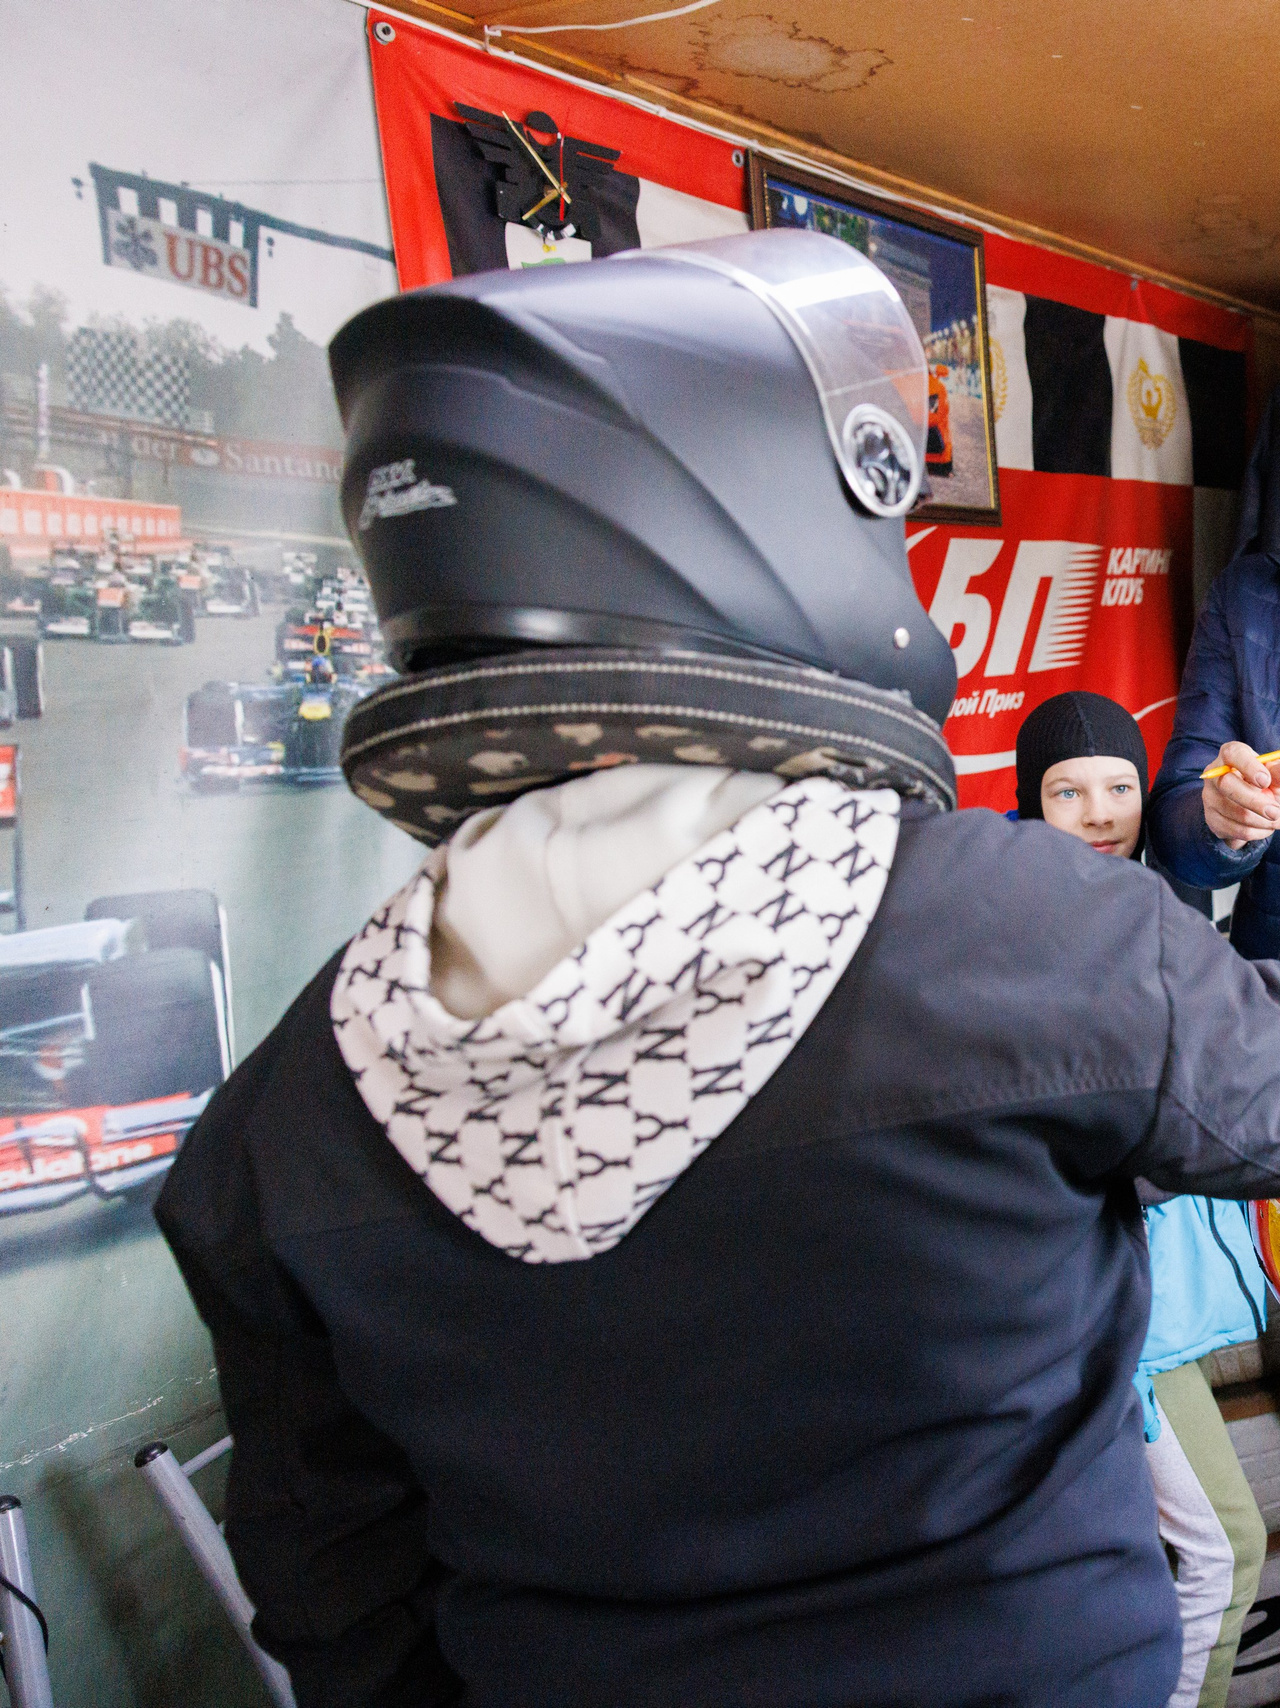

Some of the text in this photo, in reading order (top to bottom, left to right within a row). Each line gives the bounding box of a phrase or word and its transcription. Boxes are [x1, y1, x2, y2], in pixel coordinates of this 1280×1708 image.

[163, 229, 248, 299] UBS
[1106, 547, 1173, 576] КАРТИН
[1100, 577, 1145, 607] КЛУБ
[977, 688, 1026, 719] Приз
